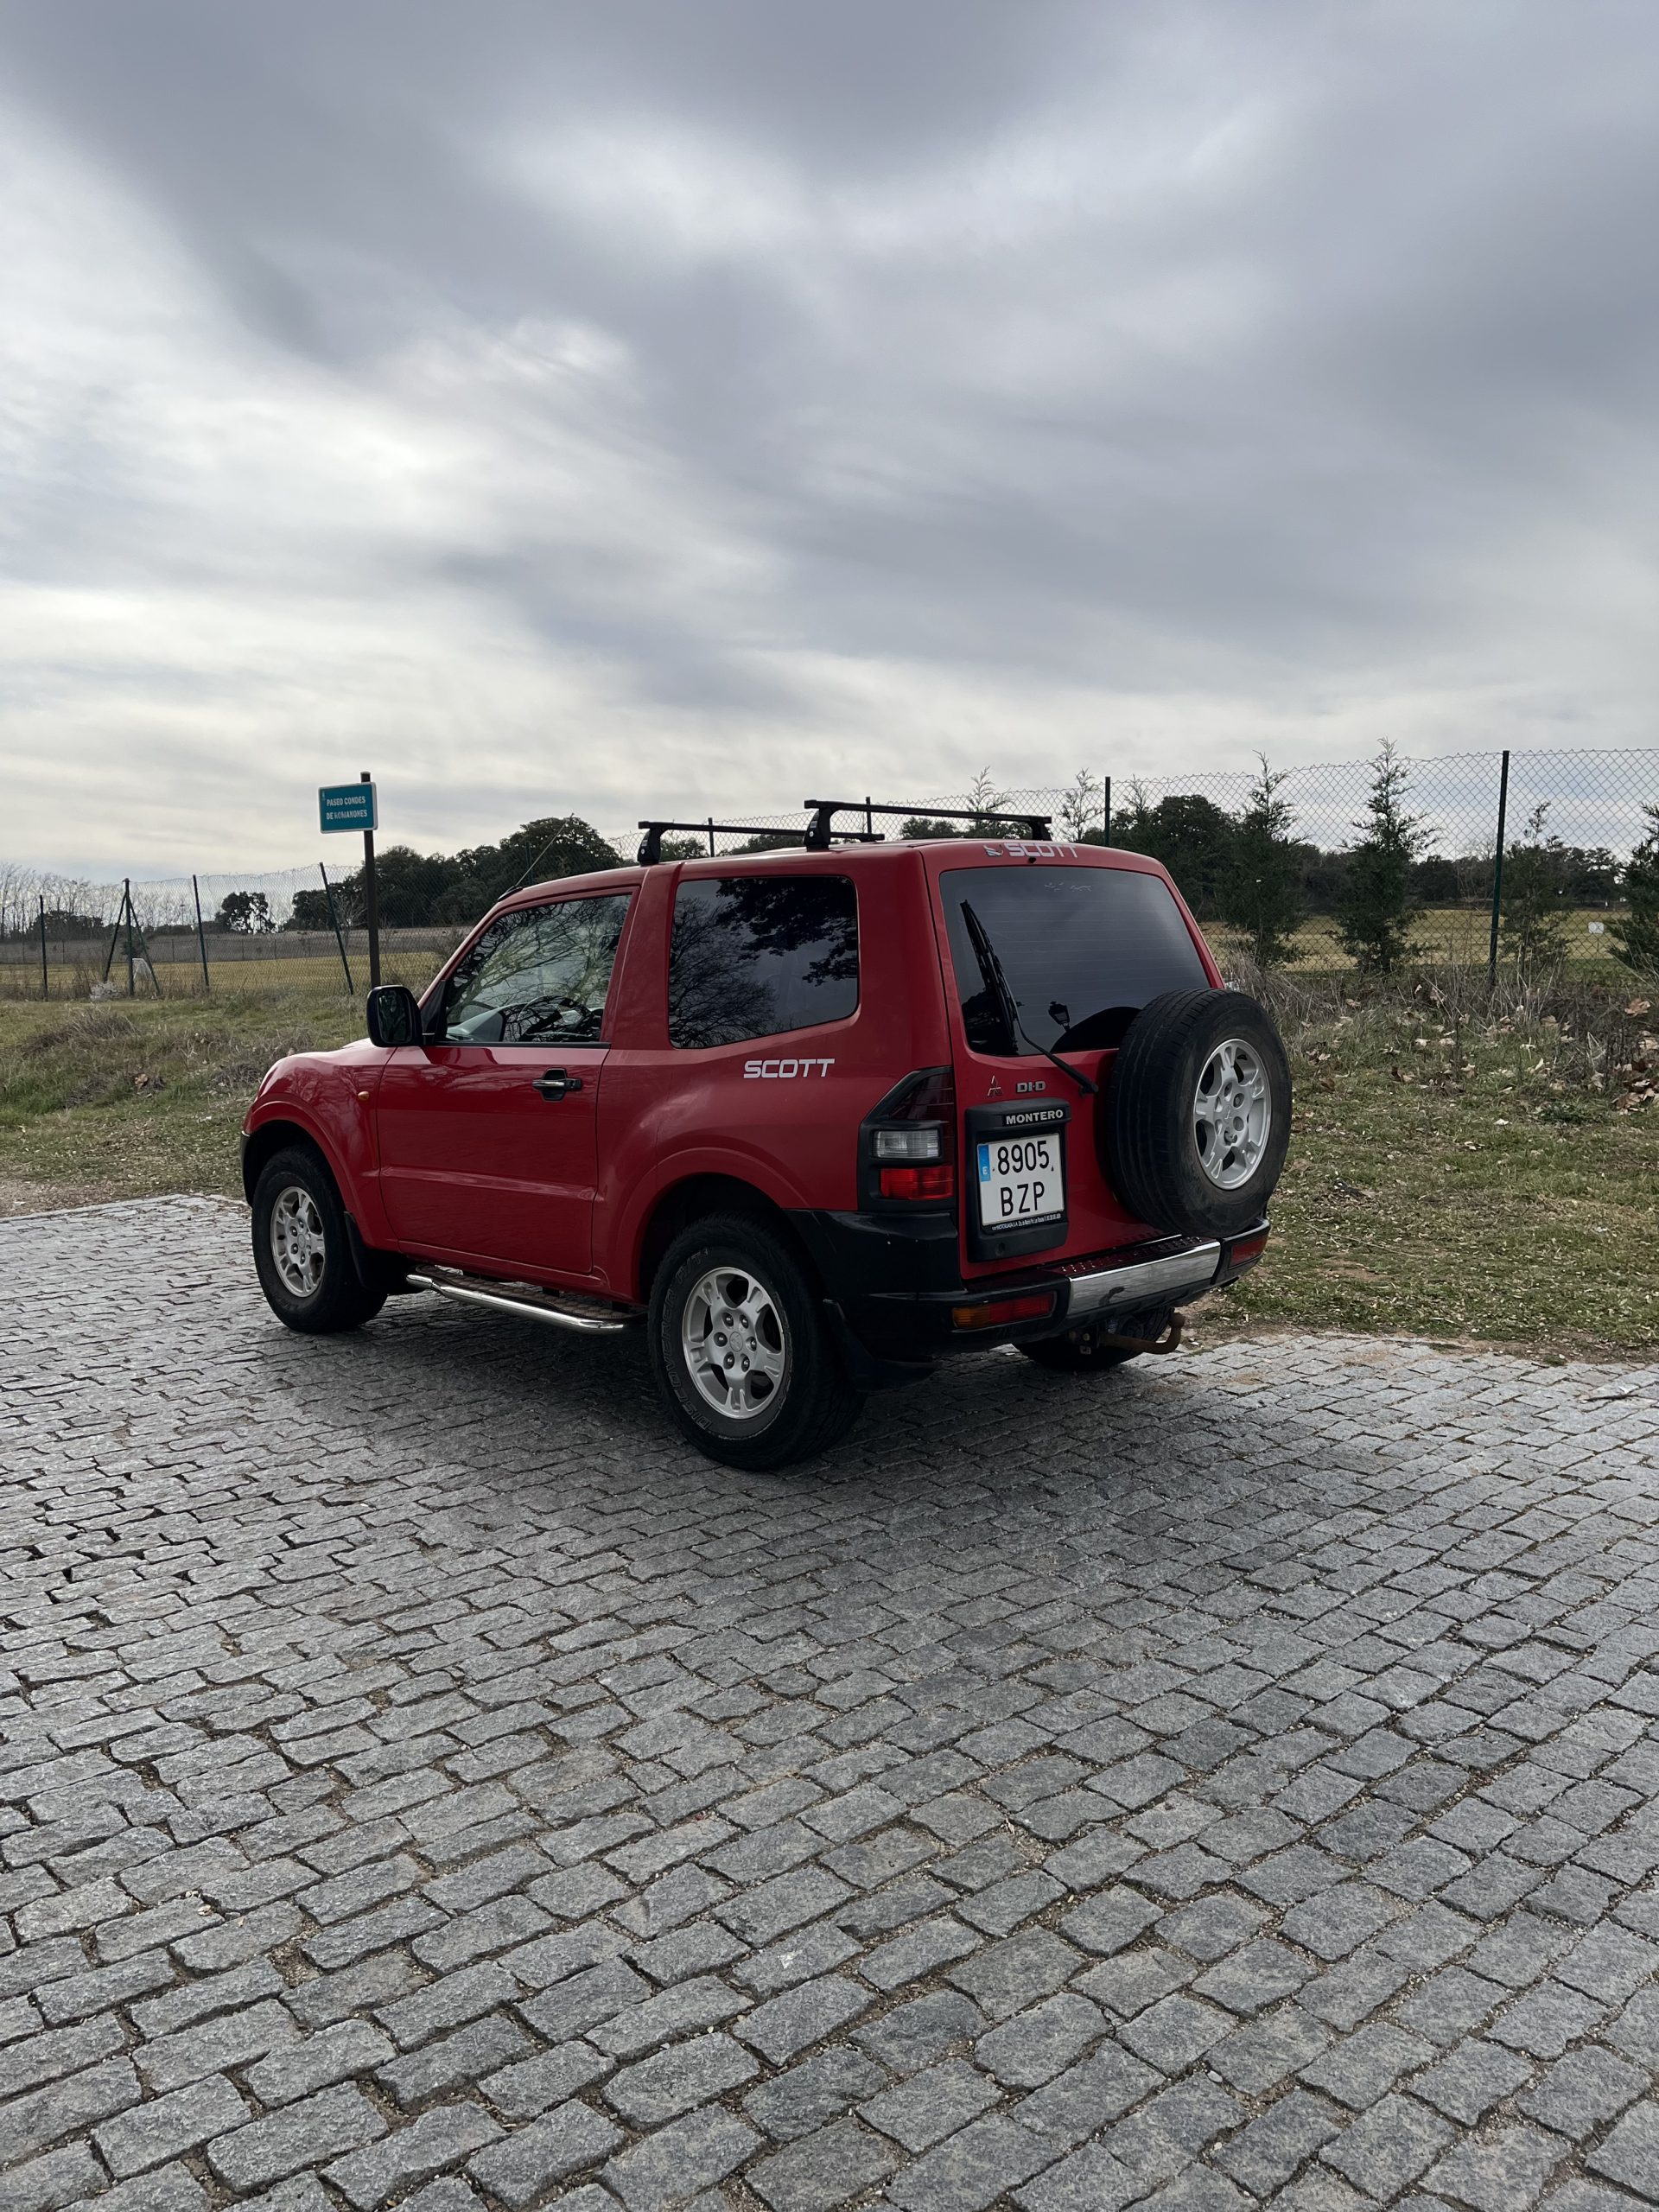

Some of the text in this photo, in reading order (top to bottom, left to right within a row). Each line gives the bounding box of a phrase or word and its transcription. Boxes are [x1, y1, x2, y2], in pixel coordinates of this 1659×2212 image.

[326, 796, 366, 807] PASEO CONDES
[326, 811, 334, 820] DE
[1003, 842, 1078, 858] SCOTT
[743, 1058, 836, 1078] SCOTT
[1006, 1109, 1064, 1125] MONTERO
[997, 1140, 1050, 1175] 8905
[982, 1166, 988, 1175] E
[1000, 1181, 1045, 1217] BZP
